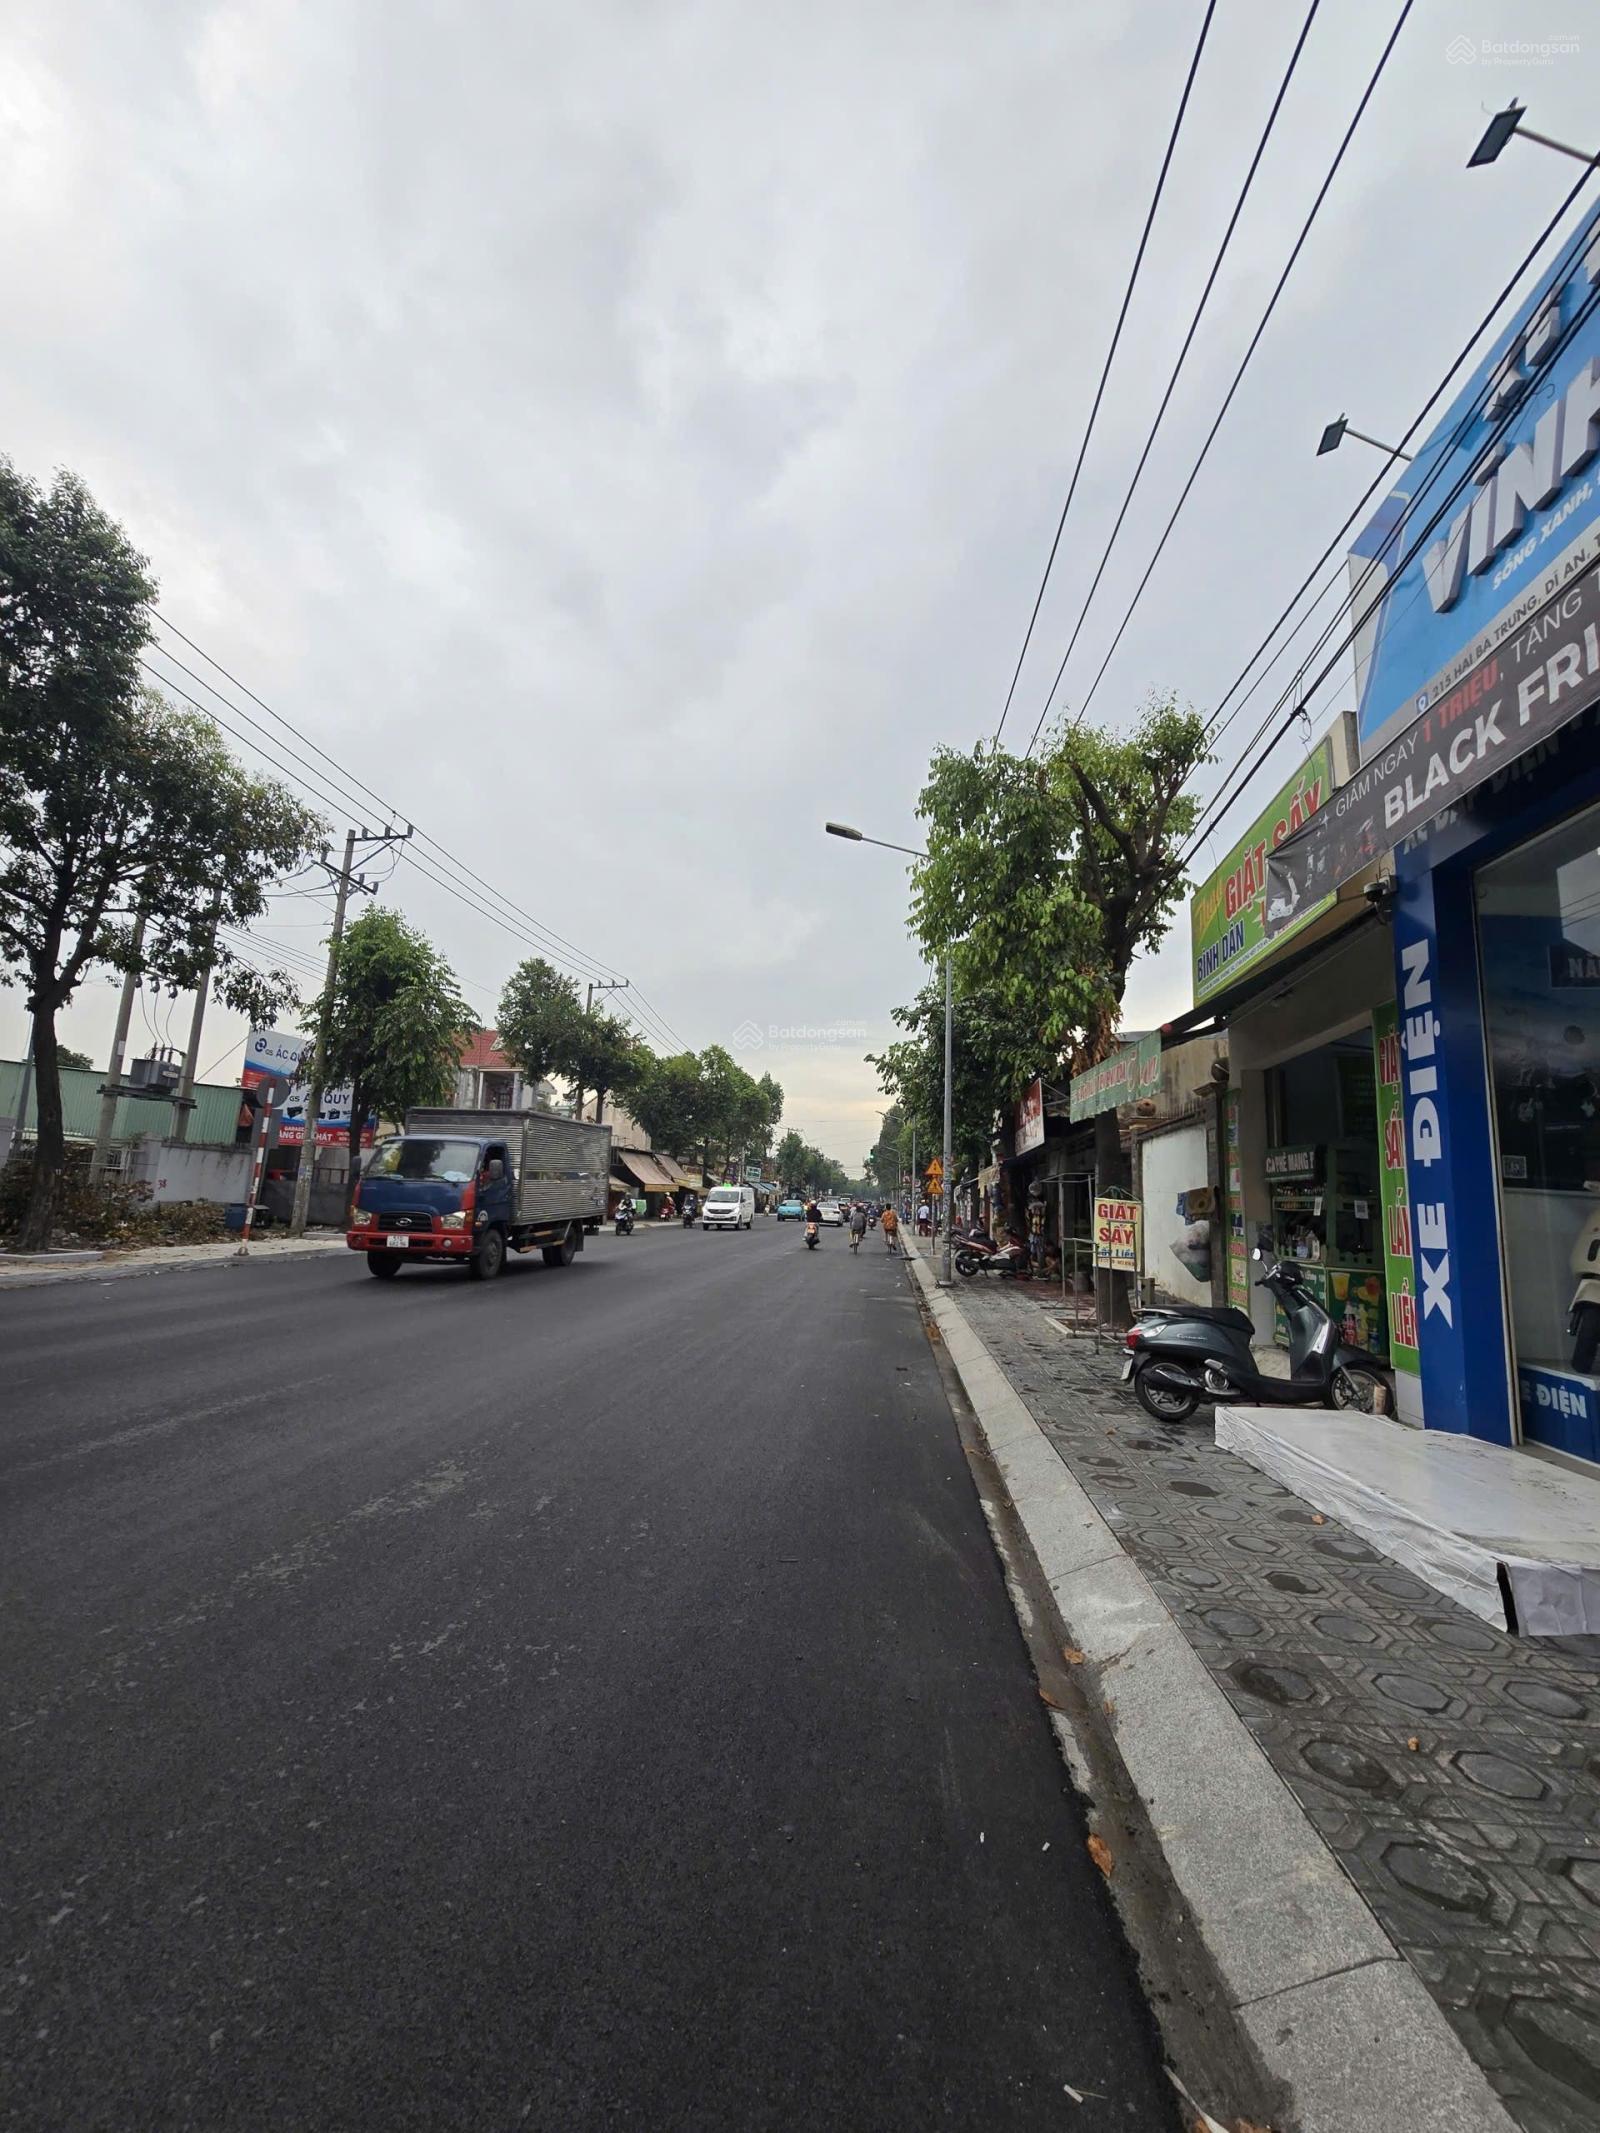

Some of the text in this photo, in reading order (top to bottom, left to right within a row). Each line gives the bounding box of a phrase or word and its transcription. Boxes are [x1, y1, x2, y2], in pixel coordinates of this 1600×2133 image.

[1454, 653, 1473, 679] HAI
[1374, 731, 1418, 786] NGAY
[1423, 718, 1433, 743] 1
[1384, 699, 1506, 829] BLACK
[1225, 838, 1267, 920] GIẶT
[1401, 938, 1453, 1330] XE ĐIỆN
[1536, 1384, 1587, 1419] ĐIỆN
